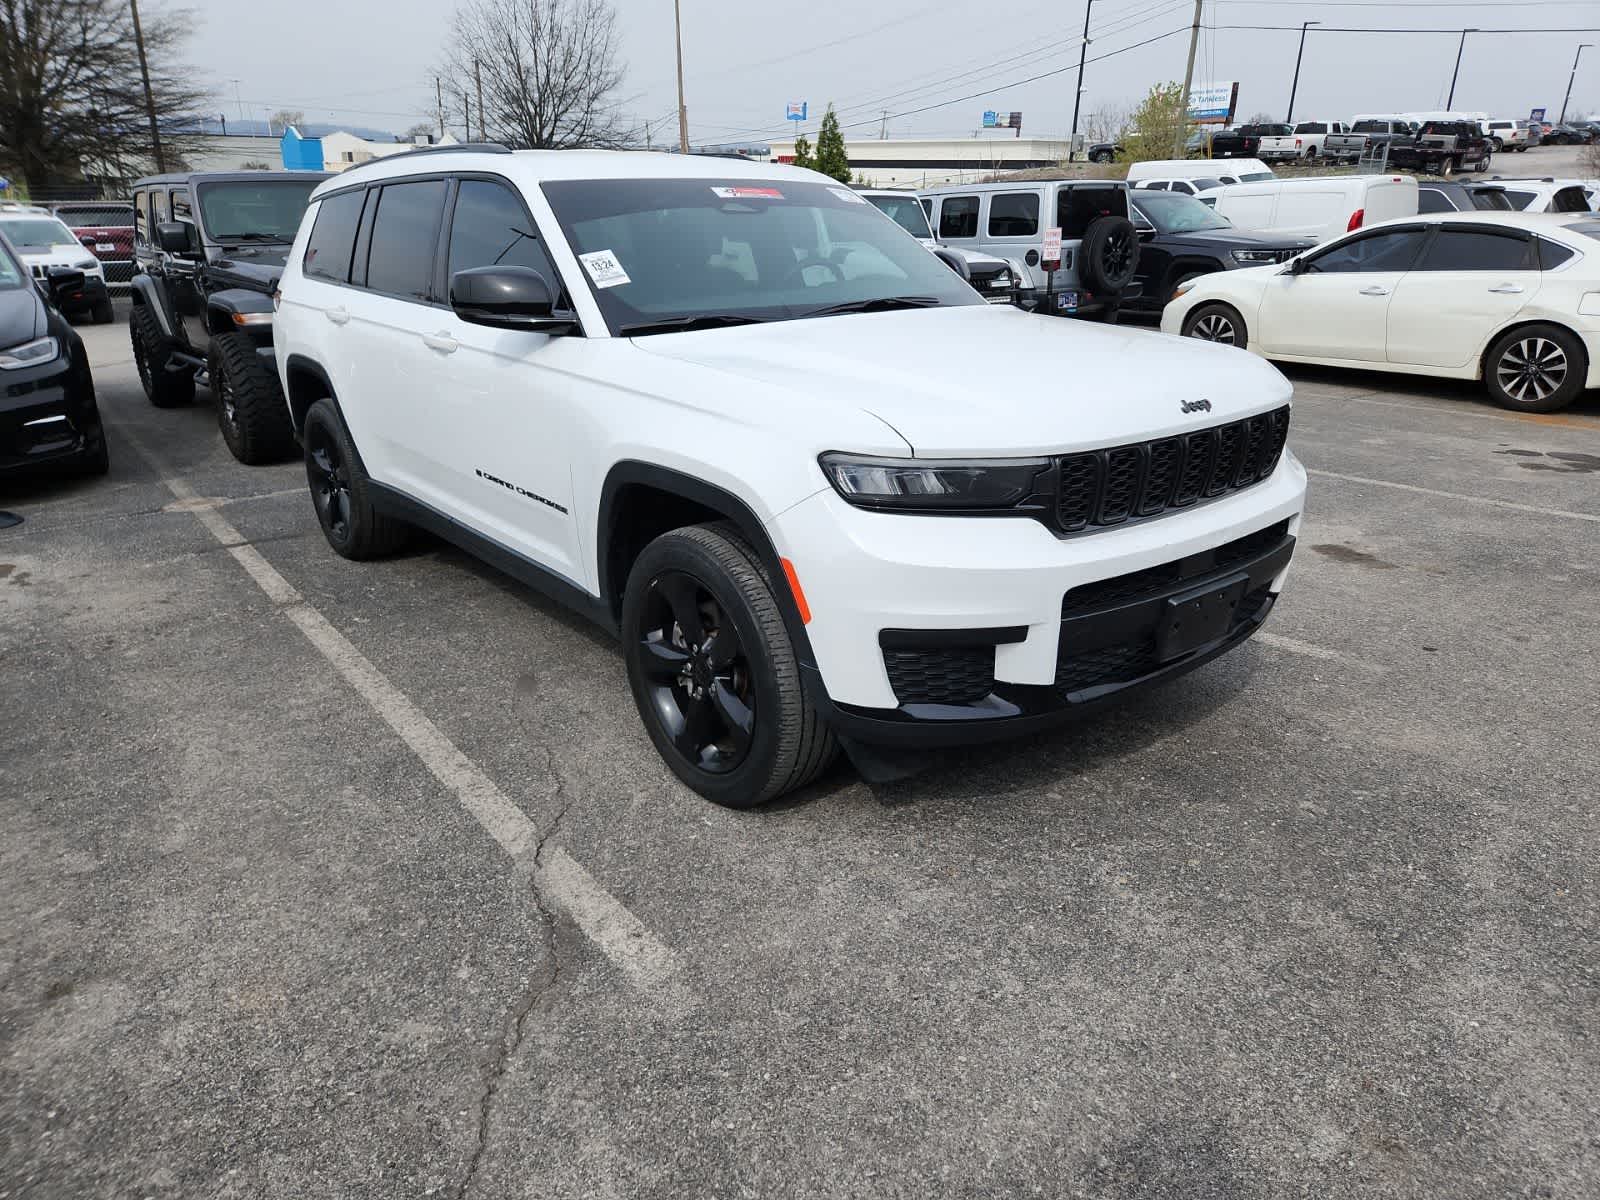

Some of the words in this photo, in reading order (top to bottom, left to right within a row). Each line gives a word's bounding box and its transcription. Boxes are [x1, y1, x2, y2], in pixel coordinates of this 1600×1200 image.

[1180, 399, 1212, 414] Jeep
[483, 472, 514, 490] GRAND
[516, 486, 569, 515] CHEROKEE
